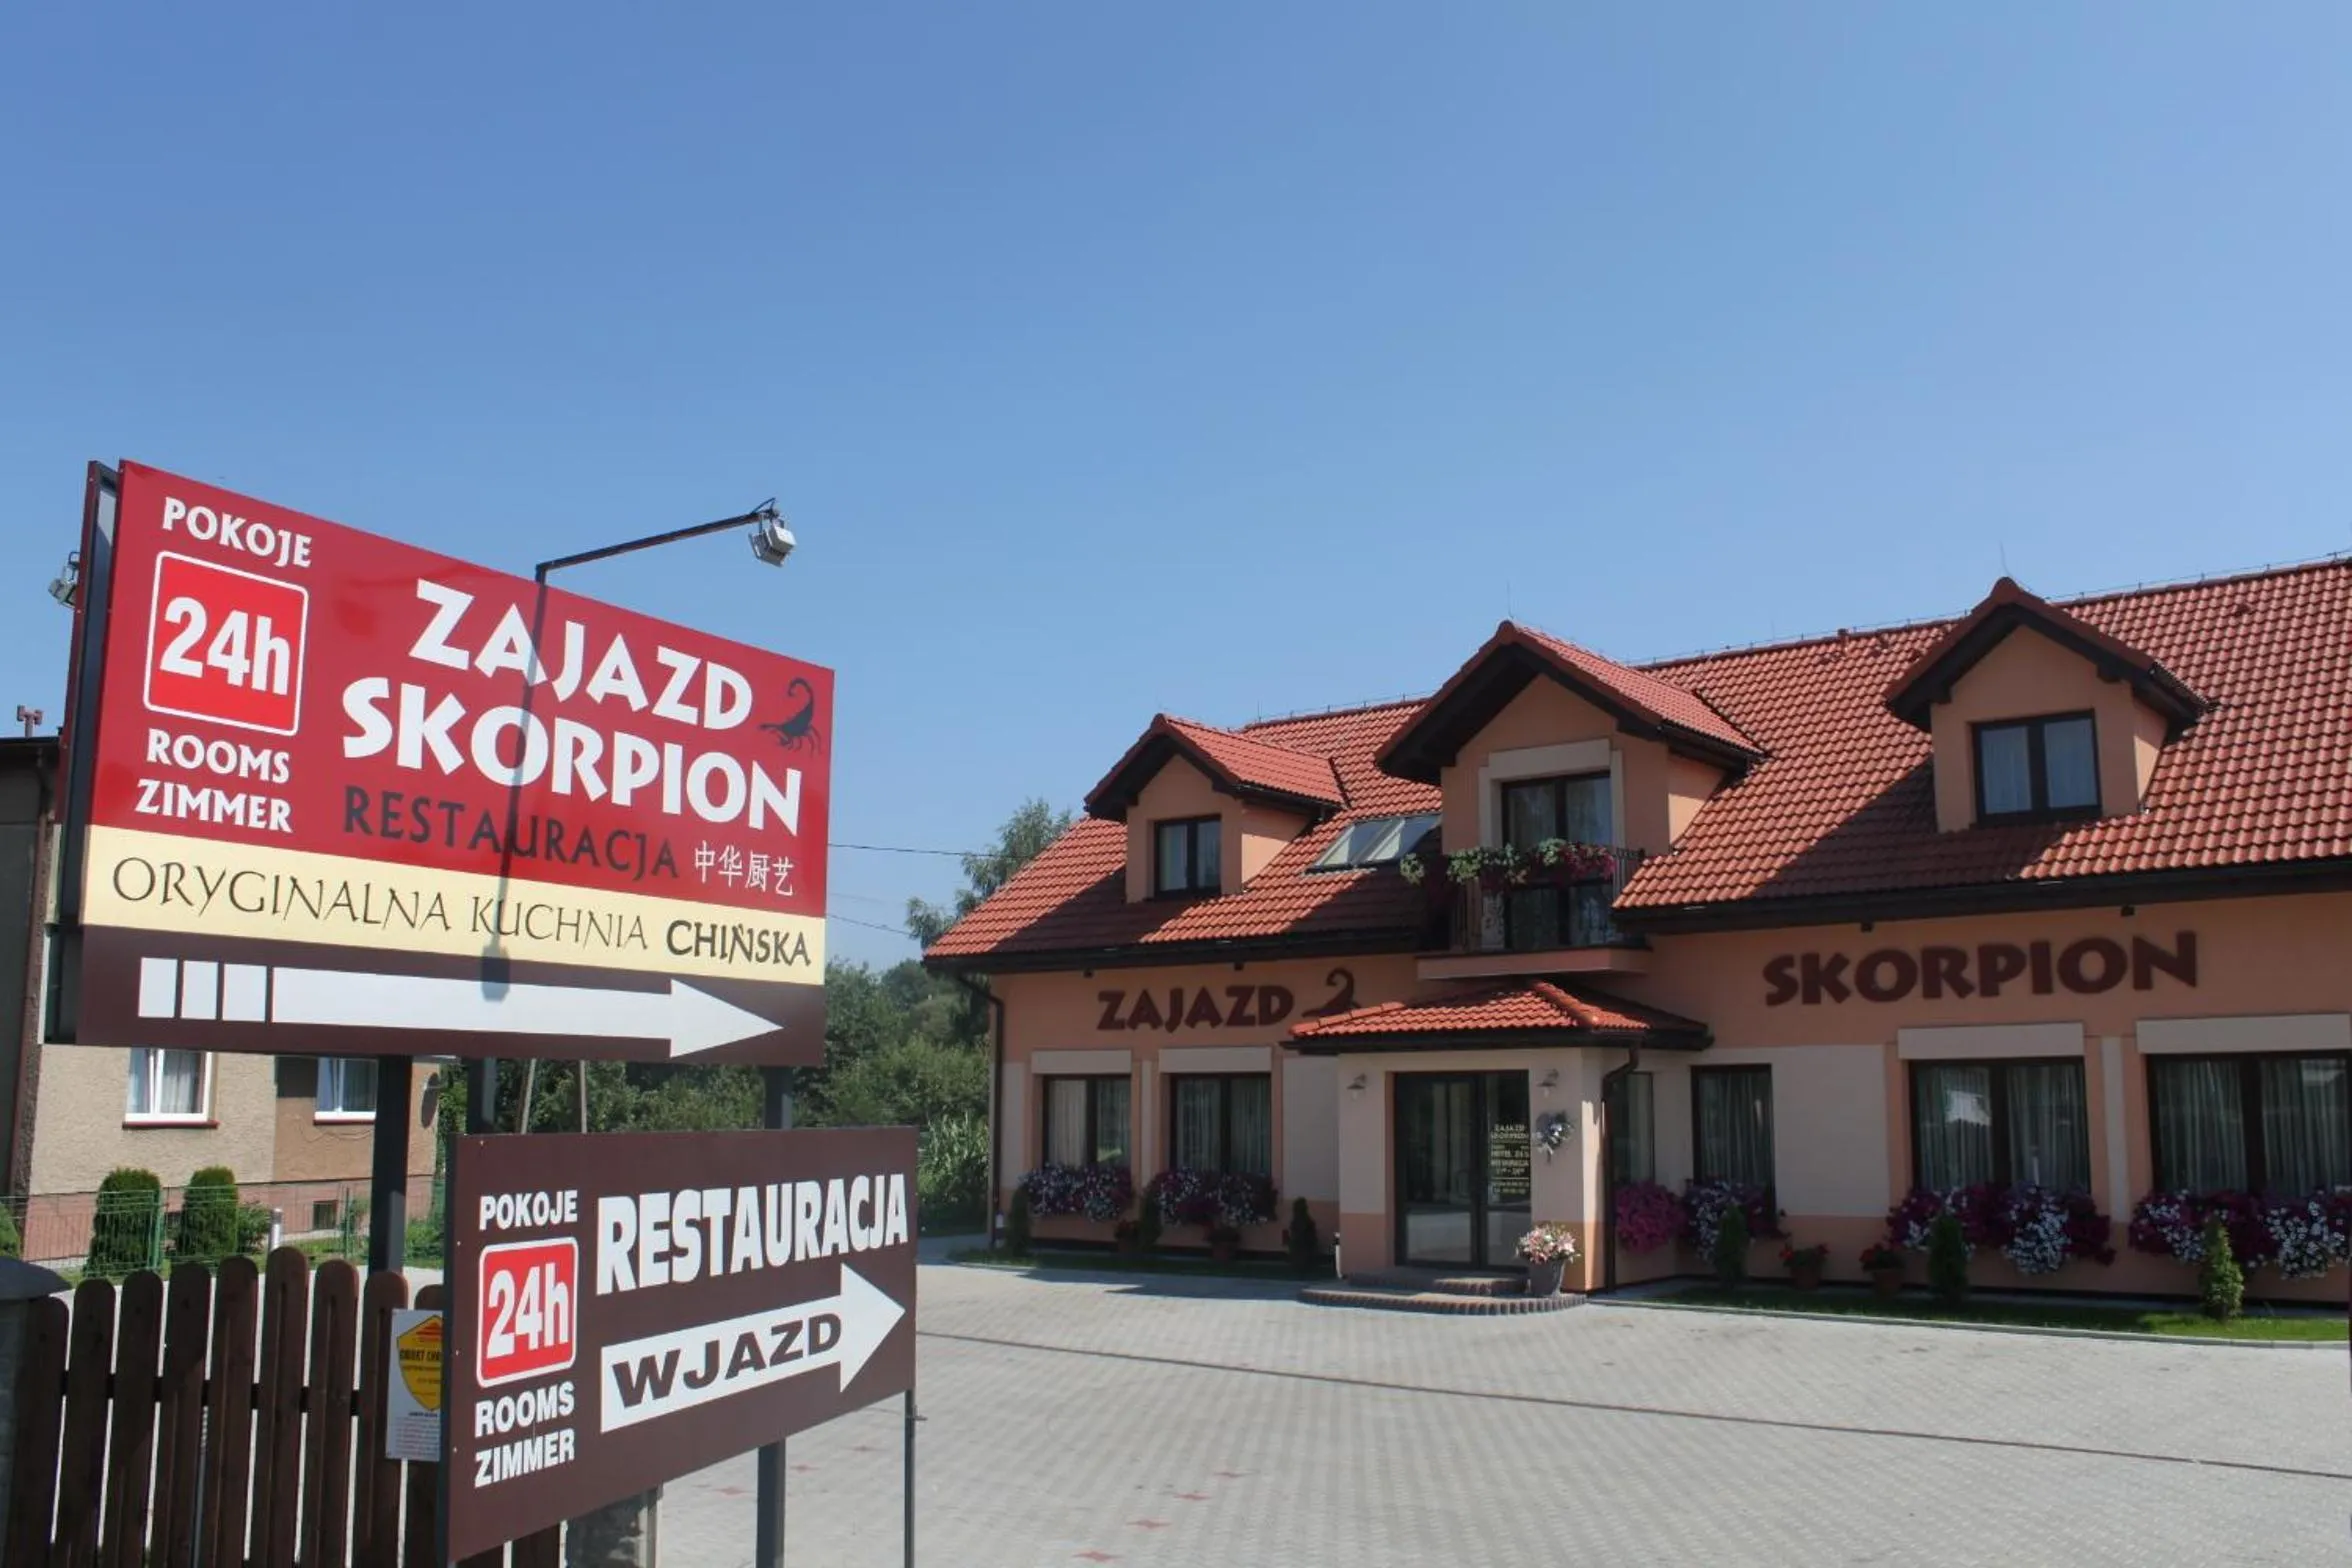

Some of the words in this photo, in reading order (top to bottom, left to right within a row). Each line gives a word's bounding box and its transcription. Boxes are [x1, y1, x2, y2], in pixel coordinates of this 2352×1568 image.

[162, 497, 312, 567] POKOJE
[160, 597, 290, 695] 24h
[409, 579, 753, 730] ZAJAZD
[147, 728, 289, 784] ROOMS
[342, 677, 801, 837] SKORPION
[135, 779, 293, 833] ZIMMER
[344, 785, 678, 881] RESTAURACJA
[694, 840, 794, 896] 中华厨艺
[113, 857, 451, 931] ORYGINALNA
[472, 896, 648, 950] KUCHNIA
[666, 919, 811, 966] CHIŃSKA
[1762, 931, 2197, 1007] SKORPION
[1096, 985, 1295, 1033] ZAJAZD
[479, 1190, 578, 1231] POKOJE
[597, 1173, 908, 1295] RESTAURACJA
[487, 1263, 569, 1359] 24h
[612, 1313, 842, 1407] WJAZD
[475, 1383, 574, 1438] ROOMS
[474, 1429, 574, 1488] ZIMMER
